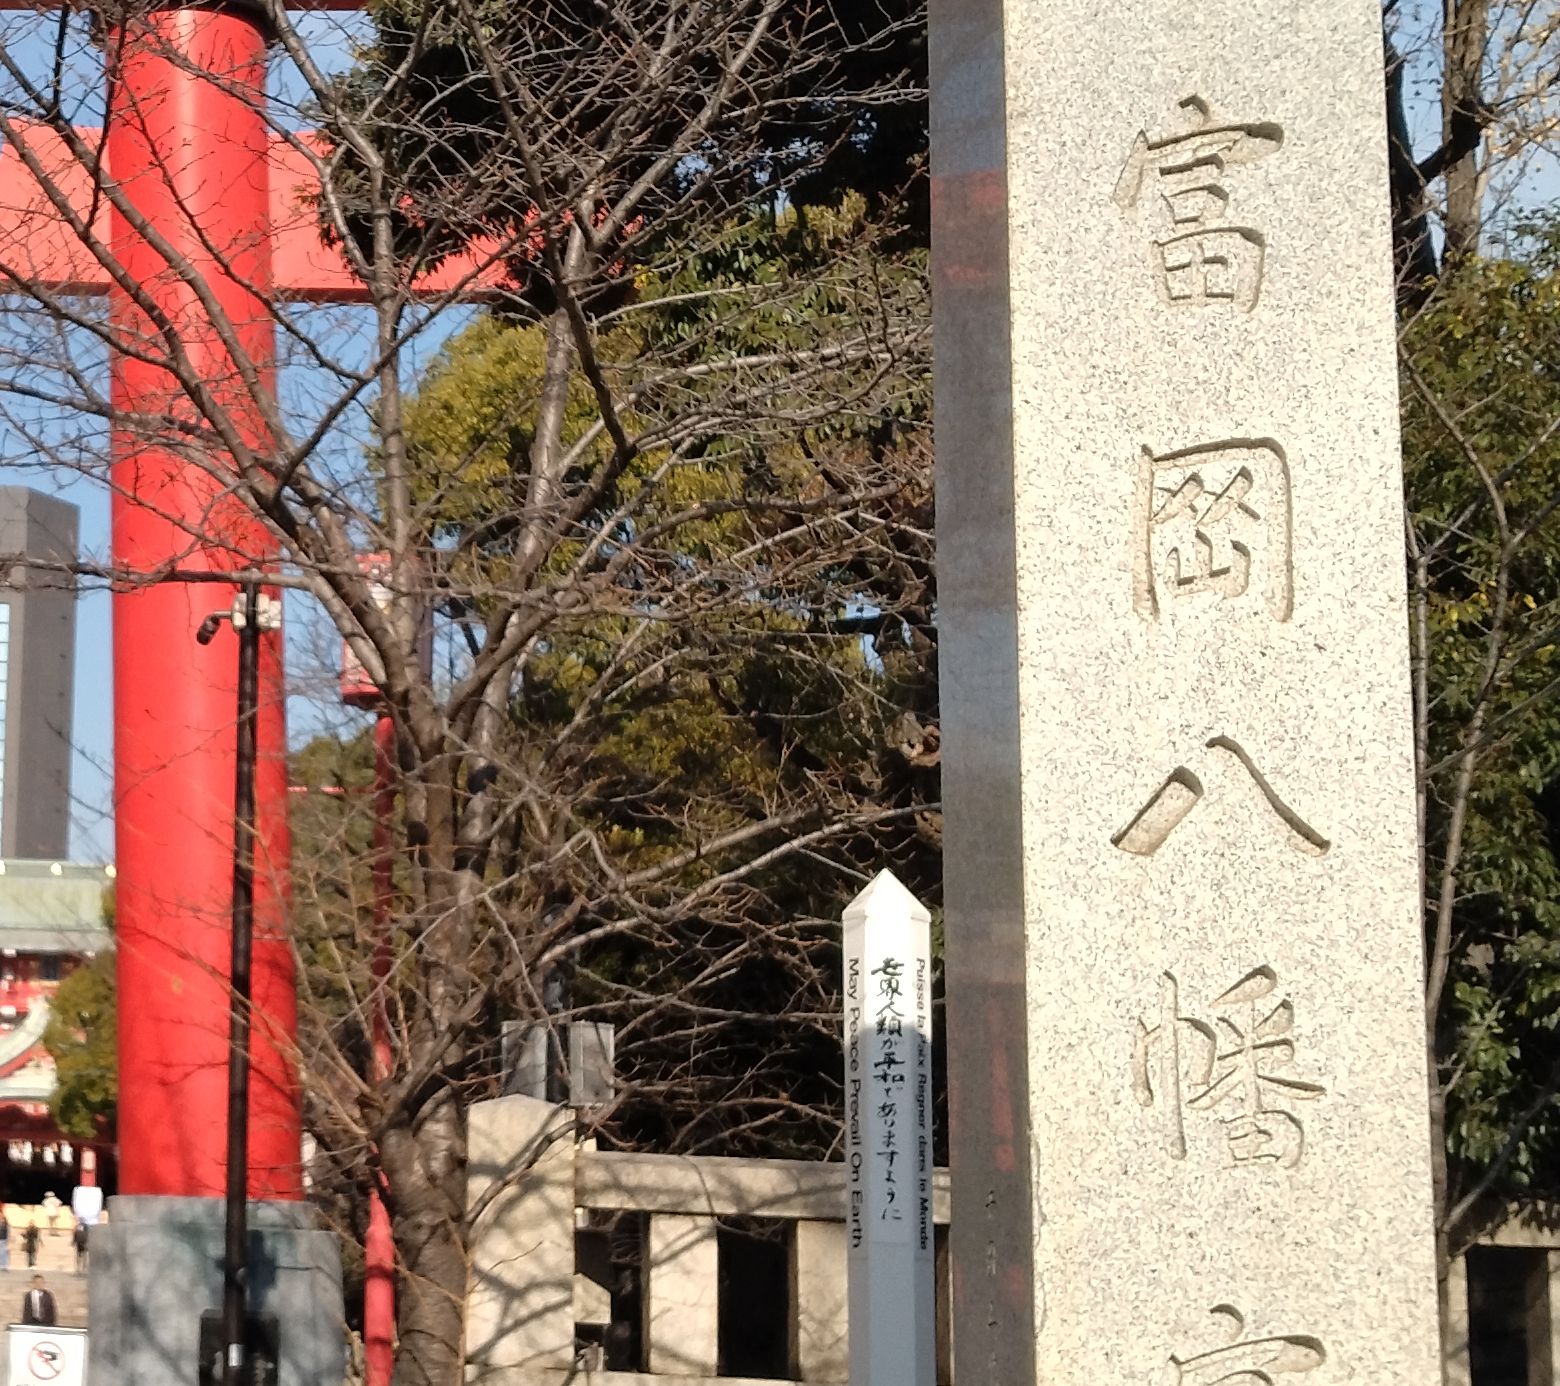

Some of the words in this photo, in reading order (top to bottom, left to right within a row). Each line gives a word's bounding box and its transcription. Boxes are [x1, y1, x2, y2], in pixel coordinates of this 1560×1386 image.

[848, 957, 860, 1000] May
[917, 958, 927, 1010] Puisse
[850, 1008, 861, 1072] Peace
[917, 1015, 927, 1028] la
[917, 1034, 927, 1066] Paix
[870, 957, 906, 1220] 世界人類が平和でありますように
[850, 1079, 862, 1146] Prevail
[851, 1152, 863, 1182] On
[918, 1135, 928, 1172] dans
[919, 1178, 929, 1192] le
[852, 1190, 863, 1248] Earth
[920, 1197, 930, 1250] Monde
